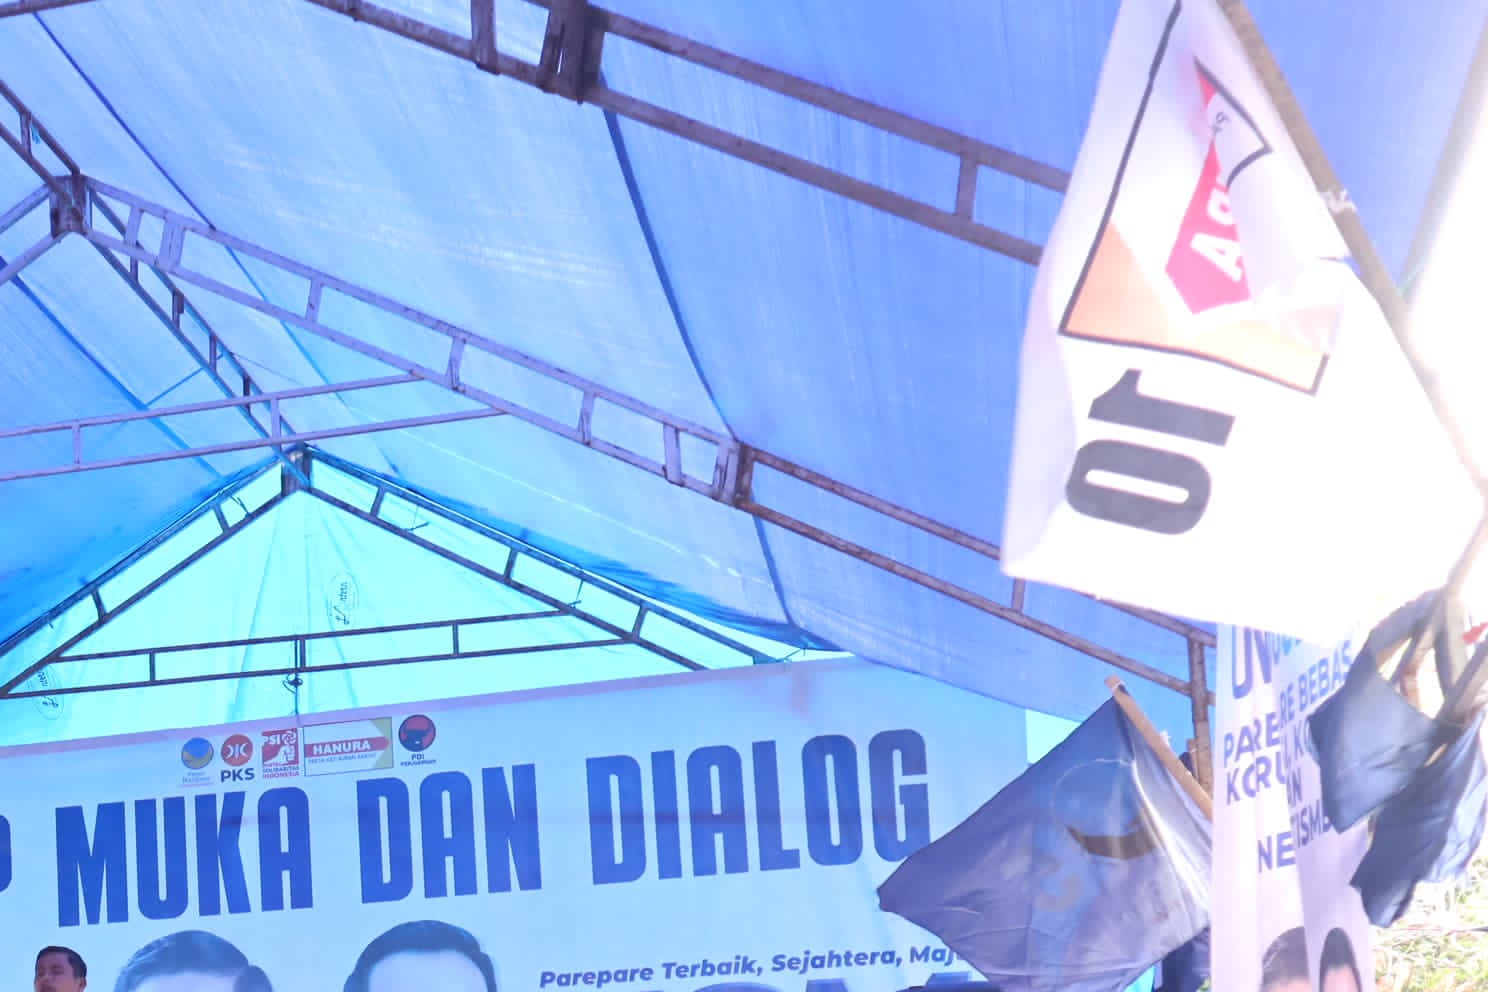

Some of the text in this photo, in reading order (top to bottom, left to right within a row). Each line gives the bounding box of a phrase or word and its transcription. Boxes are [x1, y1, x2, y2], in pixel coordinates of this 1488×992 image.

[1066, 368, 1236, 535] 10
[313, 739, 371, 755] HANURA
[220, 768, 255, 782] PKS
[55, 787, 313, 927] MUKA
[356, 763, 542, 904] DAN
[586, 729, 931, 885] DIALOG
[540, 946, 958, 988] Parepare Terbaik, Sejahtera, Maj
